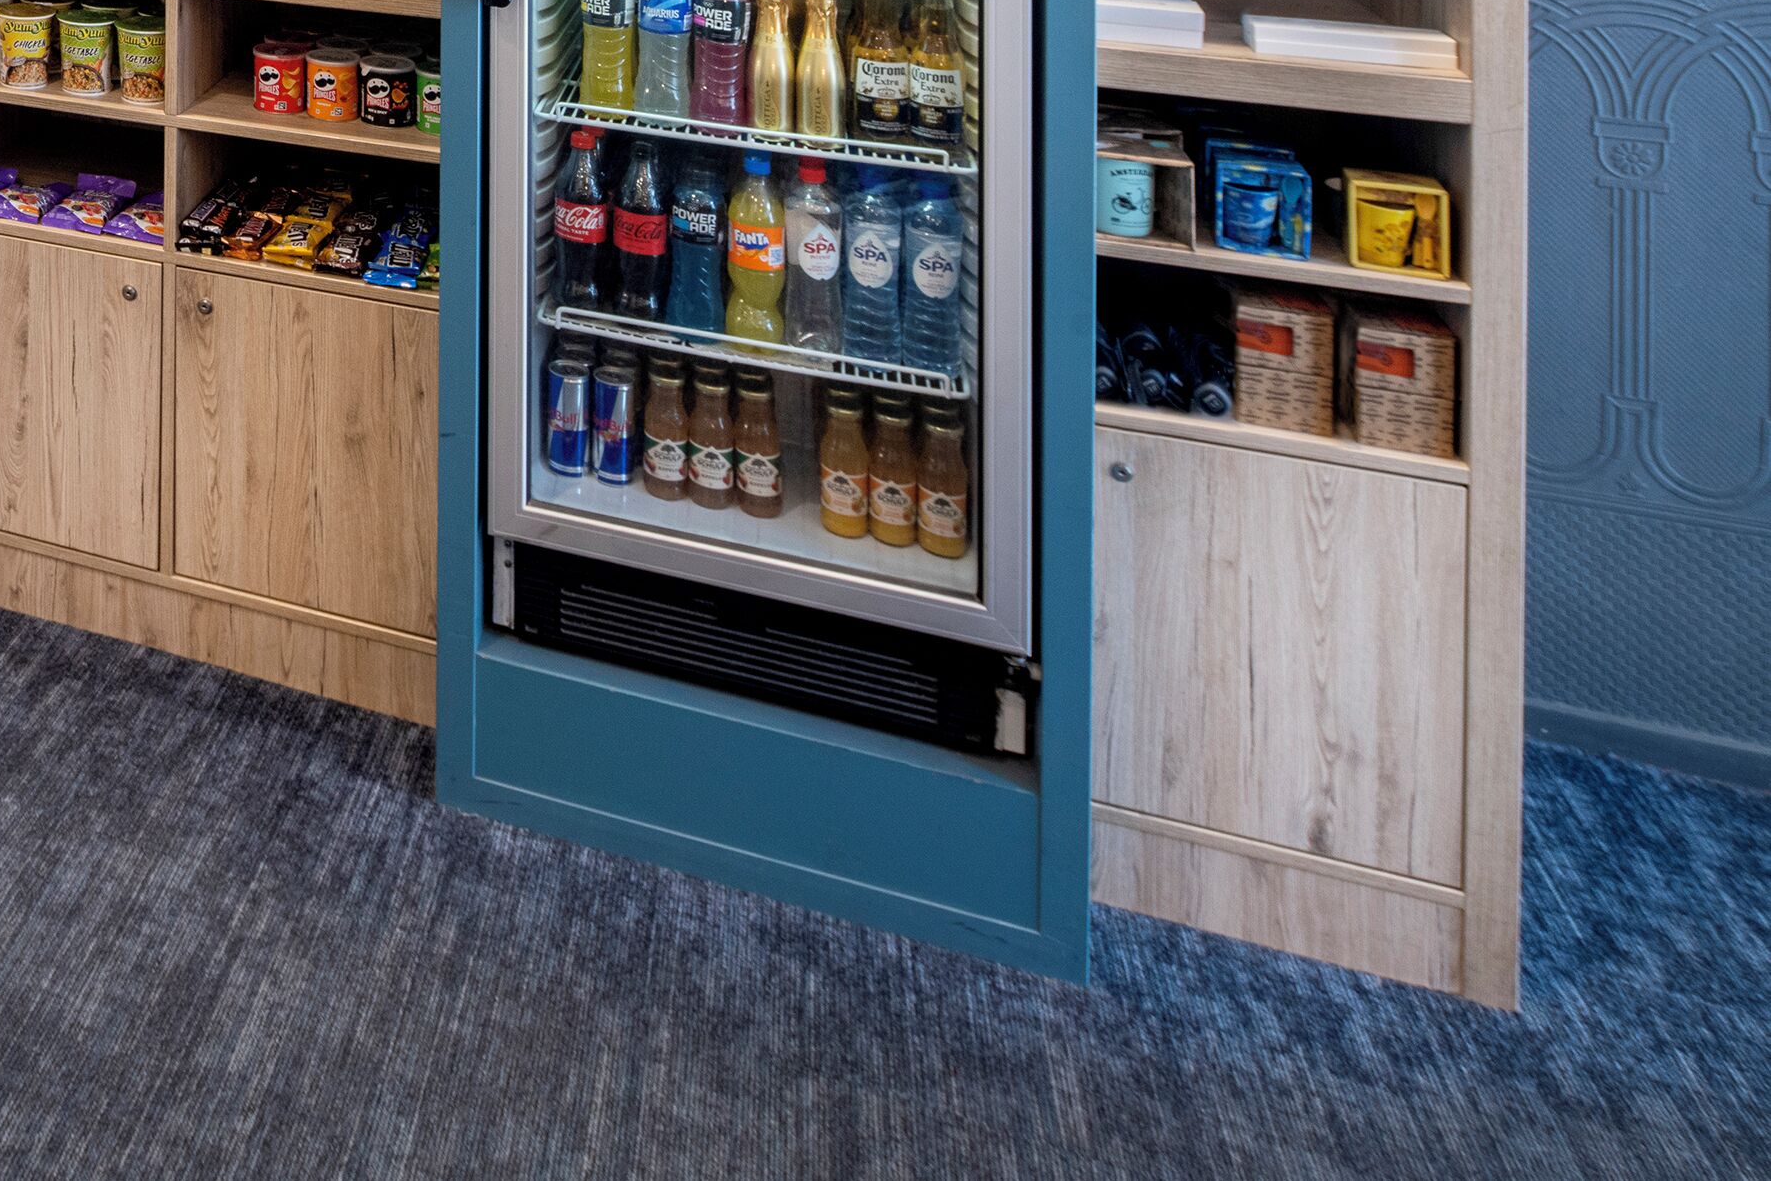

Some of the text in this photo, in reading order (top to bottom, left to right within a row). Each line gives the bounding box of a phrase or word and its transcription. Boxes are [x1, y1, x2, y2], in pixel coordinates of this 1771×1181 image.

[586, 3, 610, 16] ADE
[642, 6, 680, 19] AQUARIUS
[694, 3, 733, 21] POWER
[704, 17, 732, 31] ADE
[13, 39, 46, 49] CHICKEN
[64, 45, 99, 56] EGETABLE
[862, 61, 906, 77] Corona
[912, 67, 957, 84] Corona
[874, 76, 899, 86] Extra
[921, 82, 946, 93] Extra
[814, 96, 823, 134] OTTEGA
[672, 205, 716, 224] POWER
[689, 223, 716, 236] ADE
[734, 229, 769, 245] FANTA
[804, 242, 836, 254] SPA
[853, 246, 887, 262] SPA
[919, 259, 954, 272] SPA
